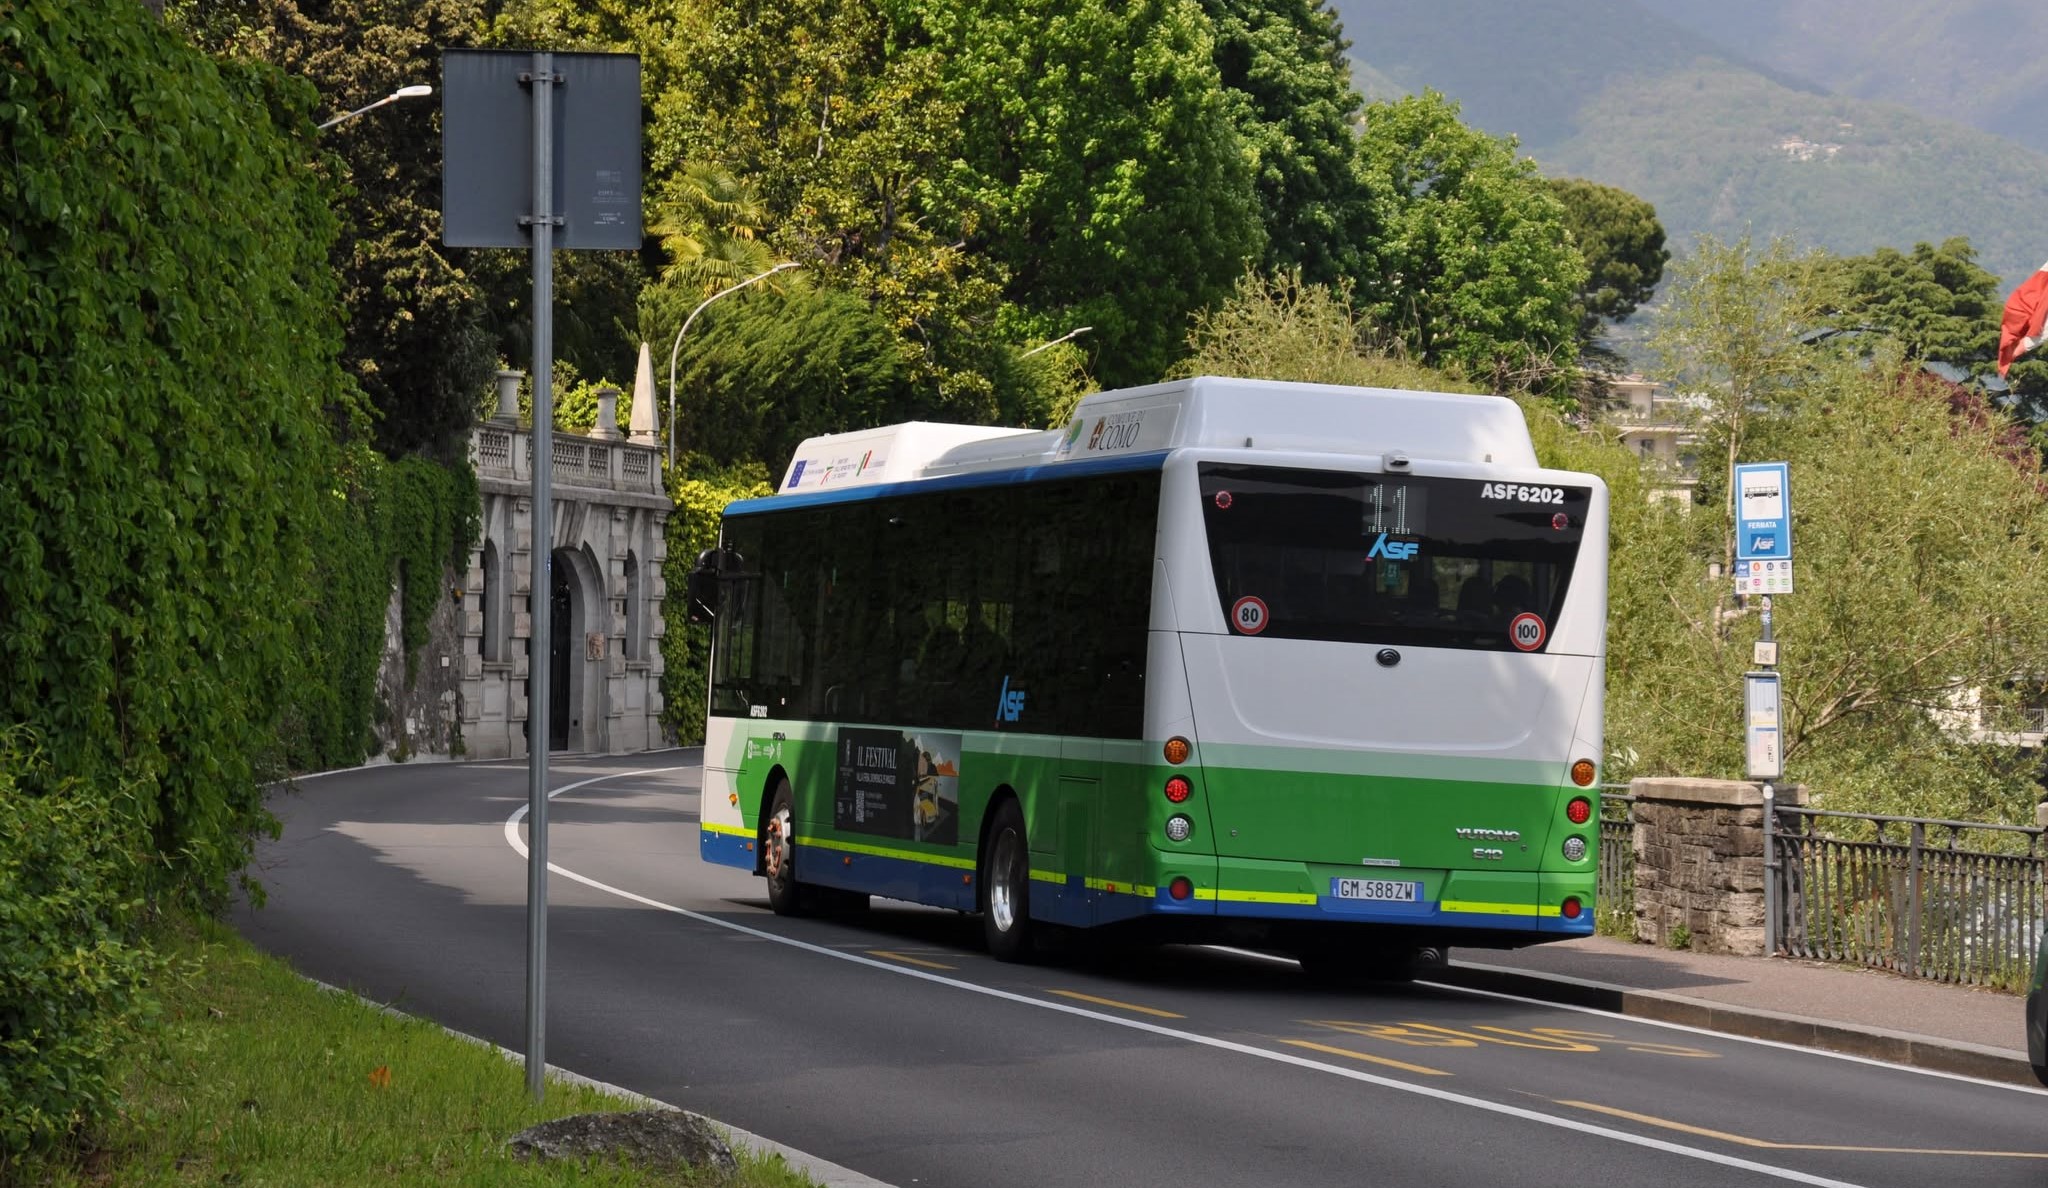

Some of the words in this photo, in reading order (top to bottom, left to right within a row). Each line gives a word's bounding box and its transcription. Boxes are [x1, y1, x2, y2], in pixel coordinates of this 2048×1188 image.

[1098, 422, 1140, 450] COMO
[1481, 483, 1564, 504] ASF6202
[1368, 484, 1411, 534] 11
[1368, 533, 1419, 560] ASF
[1752, 536, 1775, 552] ASF
[1242, 608, 1259, 622] 80
[1518, 624, 1538, 639] 100
[996, 675, 1025, 722] ASF
[857, 746, 864, 767] IL
[865, 746, 897, 769] FESTIVAL
[1341, 880, 1359, 897] GM
[1365, 883, 1413, 900] 588ZW
[1290, 1019, 1724, 1058] BUS
